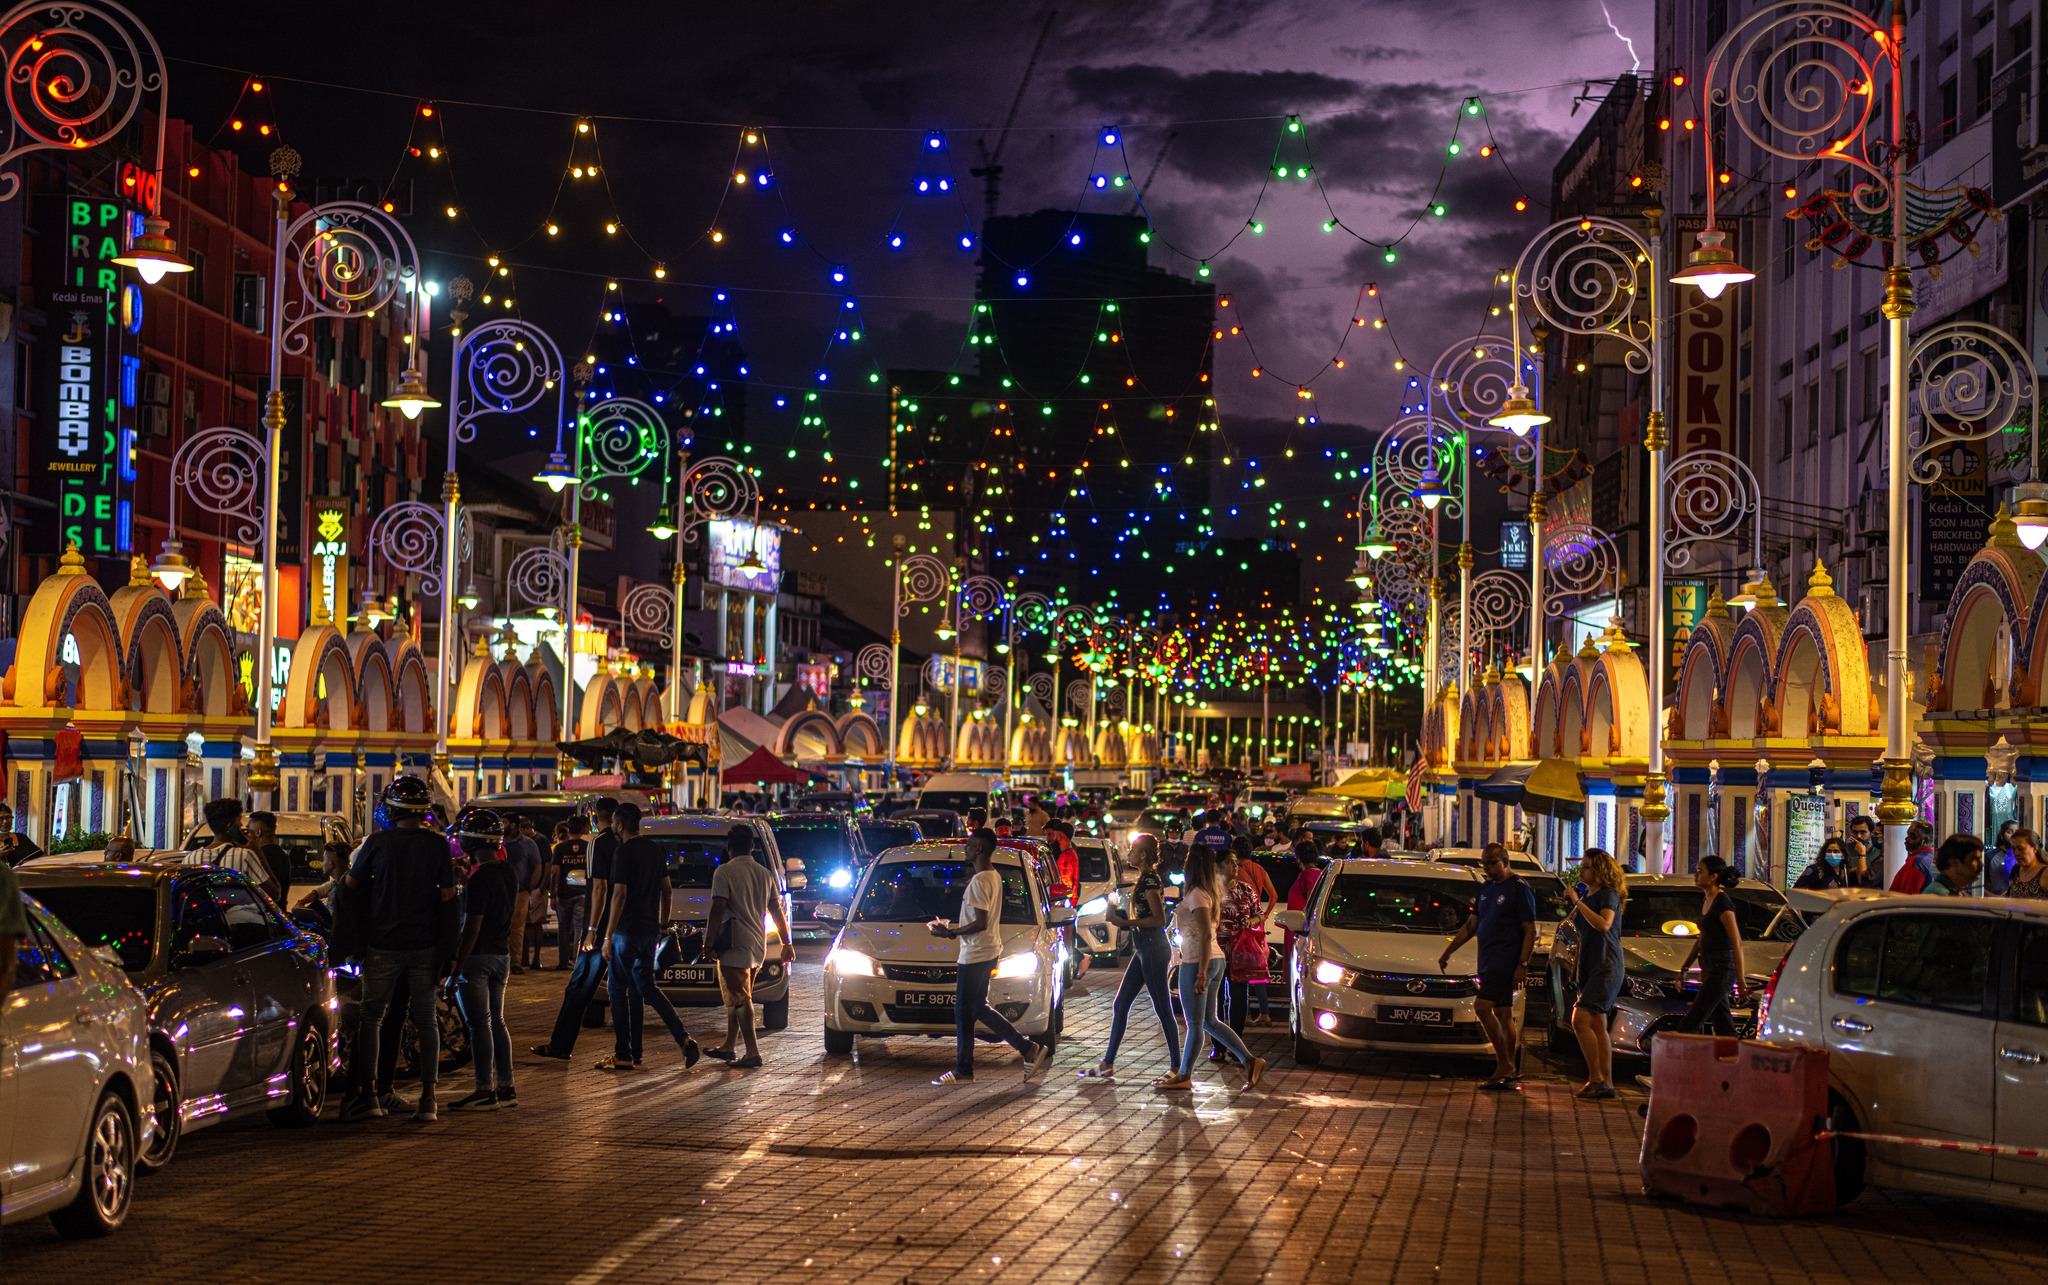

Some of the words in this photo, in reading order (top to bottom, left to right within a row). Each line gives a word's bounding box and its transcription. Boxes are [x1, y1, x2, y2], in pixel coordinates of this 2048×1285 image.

[1678, 219, 1738, 231] PASAAYA
[52, 291, 77, 302] Kedai
[80, 293, 103, 304] Emas
[47, 461, 97, 473] JEWELLERY
[1932, 479, 1984, 492] JOTUN
[1928, 502, 1961, 513] Kedai
[1965, 503, 1986, 514] Cat
[1928, 519, 1956, 527] SOON
[1960, 519, 1986, 527] HUAT
[1932, 531, 1981, 540] BRICKFIELD
[313, 541, 347, 556] ARJ
[1933, 555, 1955, 564] SDN.
[674, 969, 697, 980] 8510
[698, 969, 705, 980] H
[904, 993, 927, 1004] PLF
[1389, 1008, 1410, 1020] JRV
[1413, 1010, 1441, 1022] 4623
